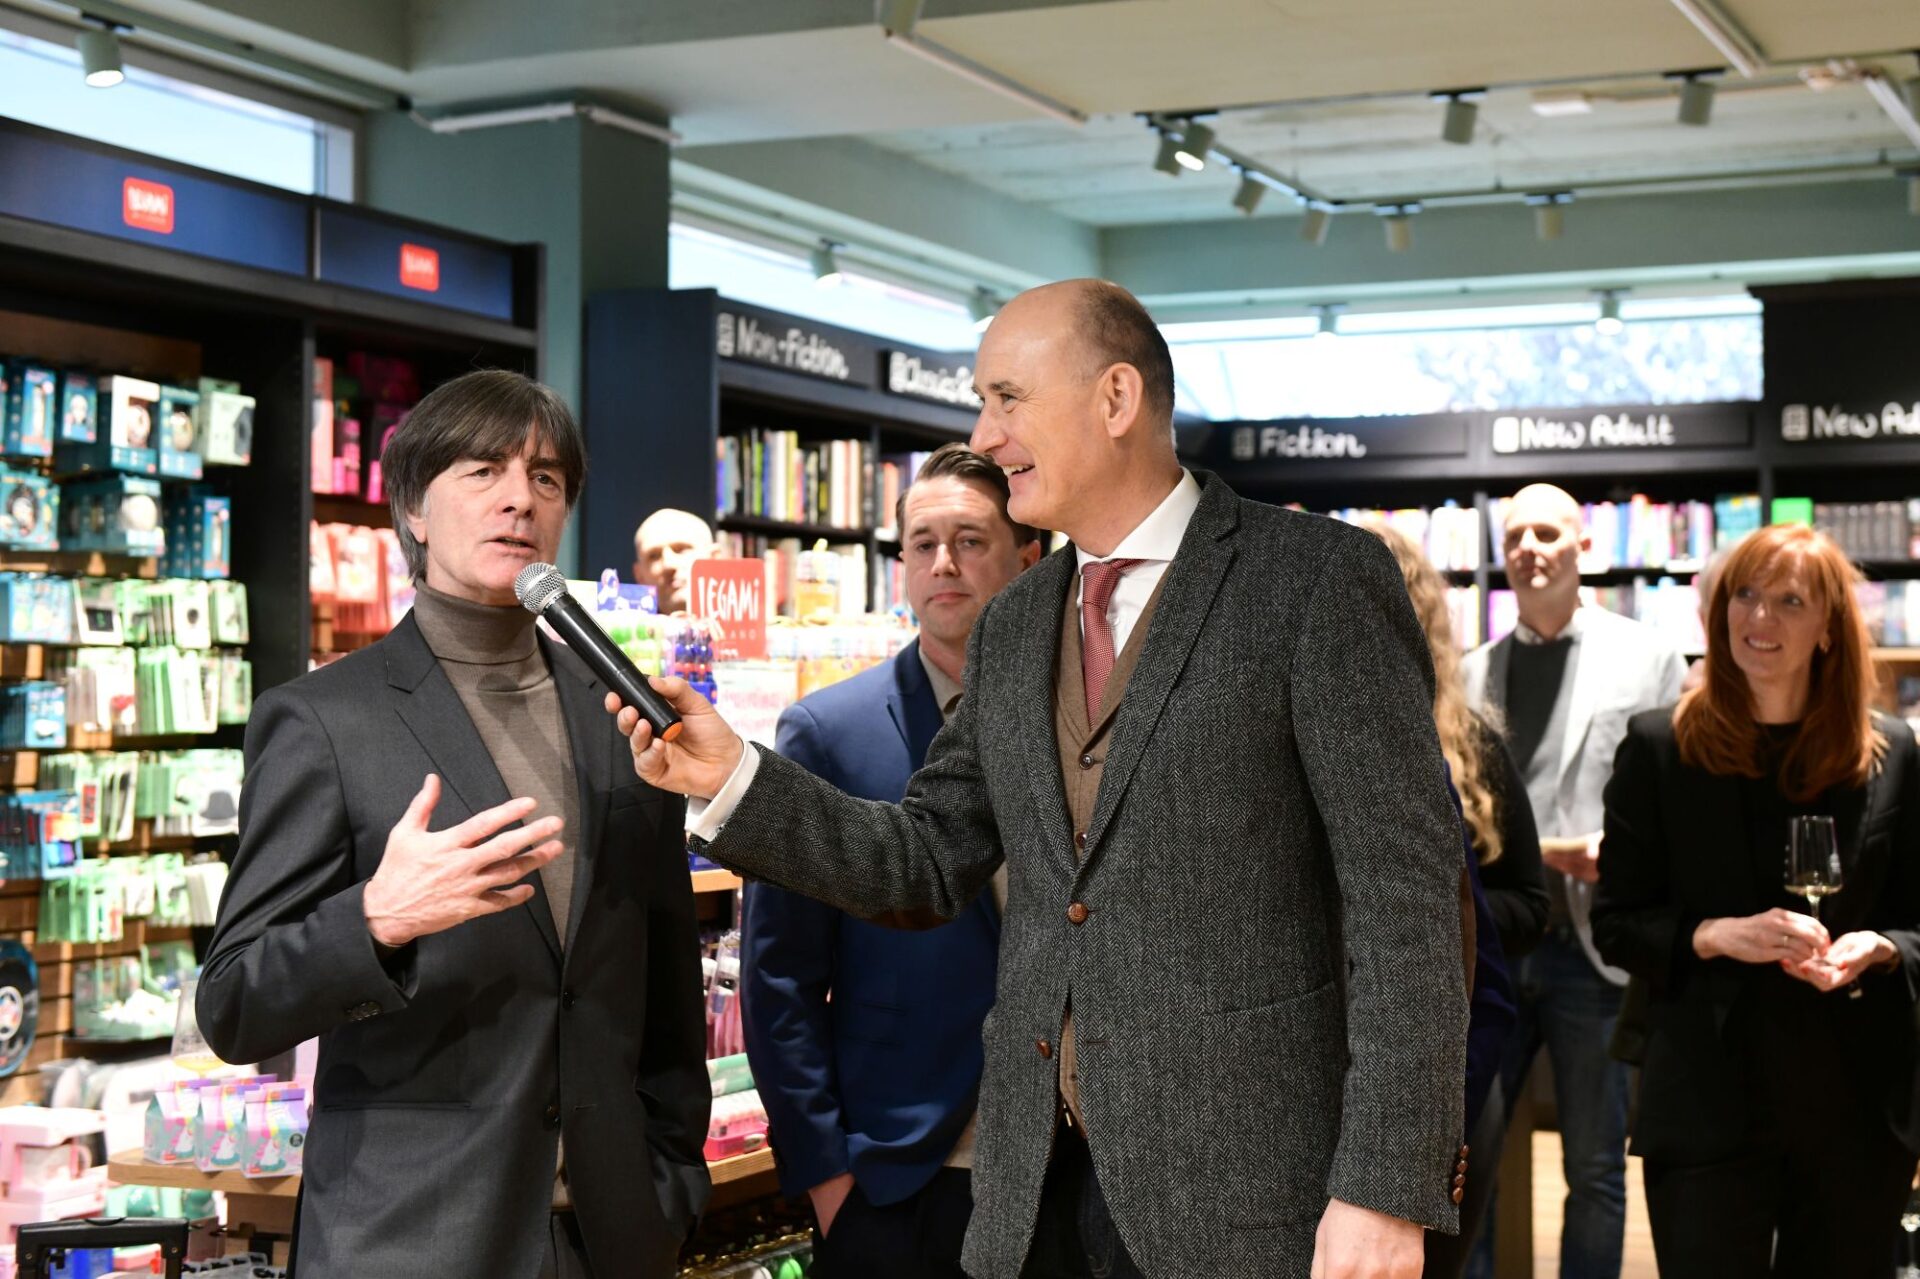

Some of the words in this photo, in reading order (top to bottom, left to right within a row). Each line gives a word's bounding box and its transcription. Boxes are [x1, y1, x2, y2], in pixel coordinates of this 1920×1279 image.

[737, 315, 849, 381] Non-Fiction
[1520, 416, 1586, 449] New
[1589, 412, 1676, 446] Adult
[1812, 404, 1879, 438] New
[1259, 424, 1367, 458] Fiction
